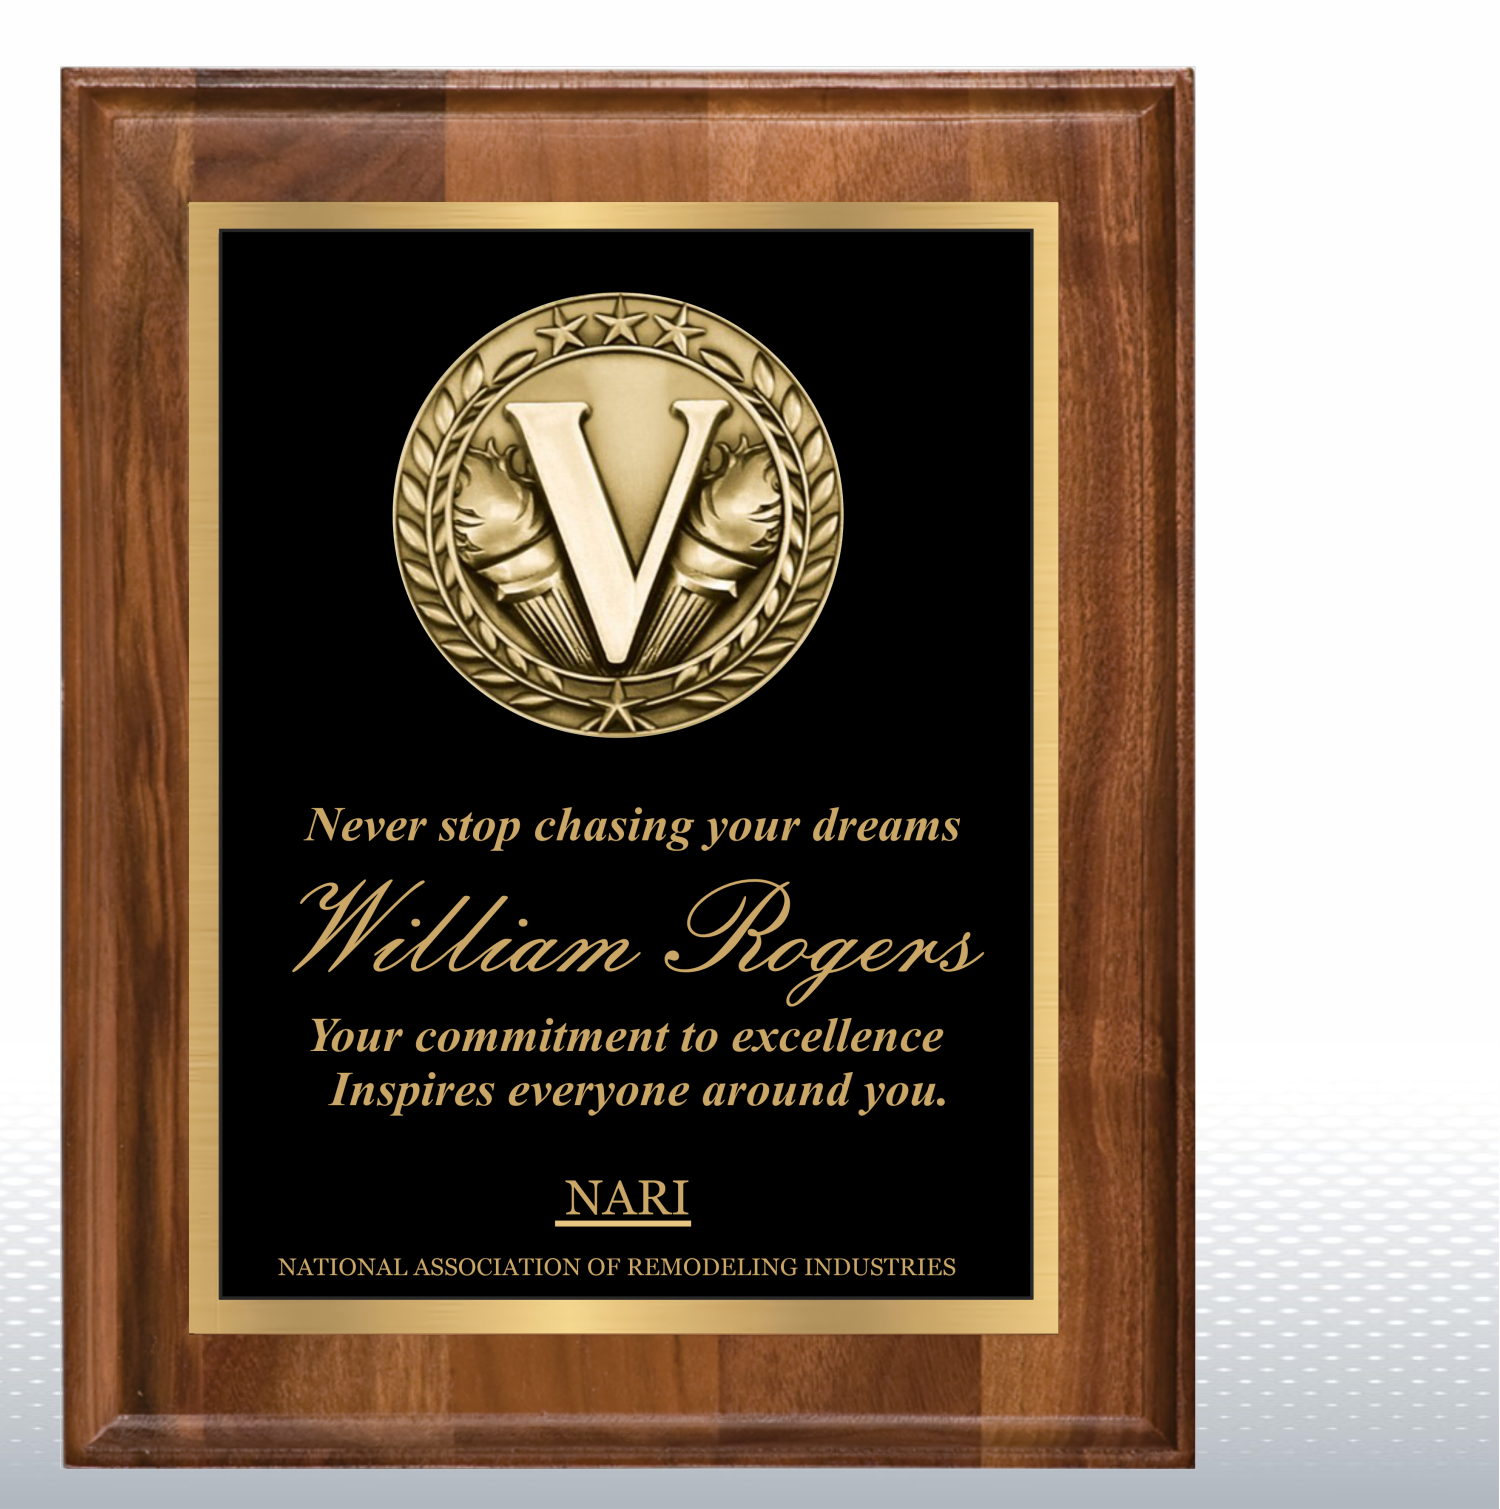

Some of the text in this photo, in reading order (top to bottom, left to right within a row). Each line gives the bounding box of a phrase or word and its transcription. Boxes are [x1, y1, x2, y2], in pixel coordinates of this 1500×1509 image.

[303, 806, 961, 852] Never stop chasing your dreams
[291, 878, 985, 1008] William Rogers
[309, 1017, 944, 1053] Your commitment to excellence
[327, 1071, 946, 1117] Inspires everyone around you.
[564, 1179, 689, 1216] NARI
[277, 1257, 956, 1277] NATIONAL ASSOCIATION OF REMODELING INDUSTRIES
